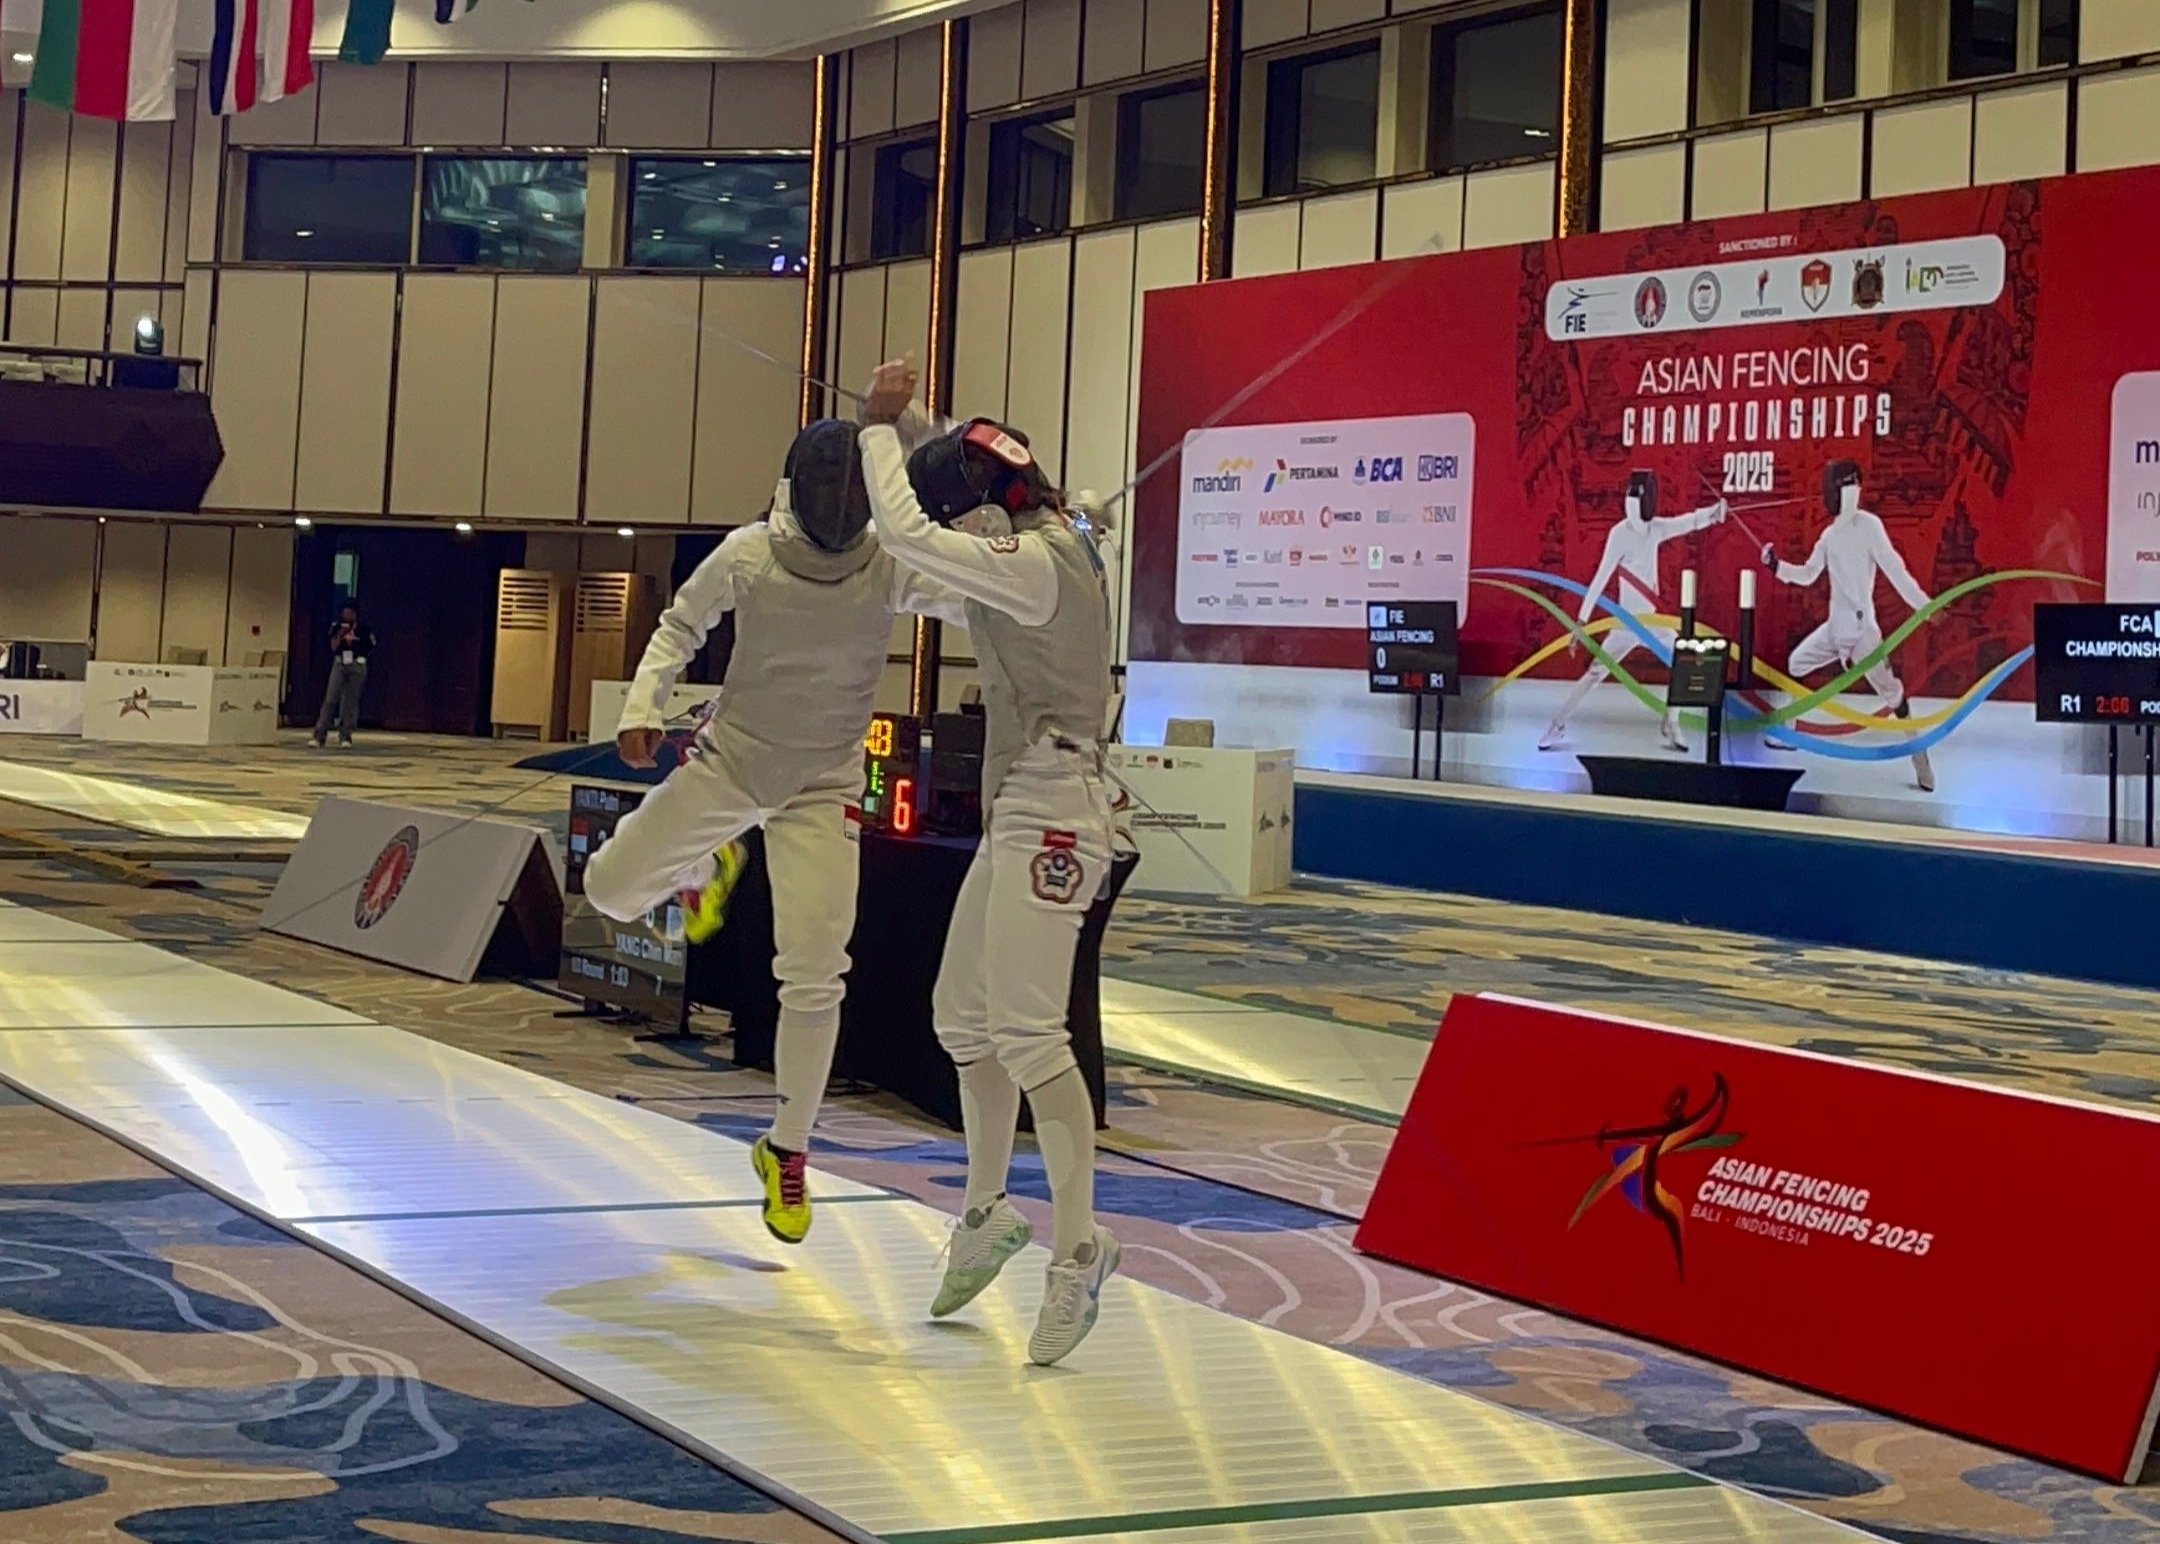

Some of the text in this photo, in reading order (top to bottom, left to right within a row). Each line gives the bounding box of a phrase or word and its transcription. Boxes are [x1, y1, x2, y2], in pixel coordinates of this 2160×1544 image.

[1564, 313, 1587, 333] FIE
[1636, 343, 1869, 395] ASIAN FENCING
[1622, 393, 1891, 447] CHAMPIONSHIPS
[1193, 470, 1241, 493] mandiri
[1289, 466, 1339, 480] PERTAMINA
[1370, 457, 1403, 482] BCA
[1433, 455, 1458, 479] BRI
[1722, 451, 1775, 493] 2025
[2120, 615, 2153, 633] FCA
[2060, 694, 2080, 713] R1
[893, 778, 912, 833] 6
[1708, 1156, 1870, 1212] ASIAN FENCING
[1690, 1203, 1722, 1223] BALI
[1734, 1215, 1810, 1246] INDONESIA
[1697, 1180, 1935, 1257] CHAMPIONSHIPS 2025
